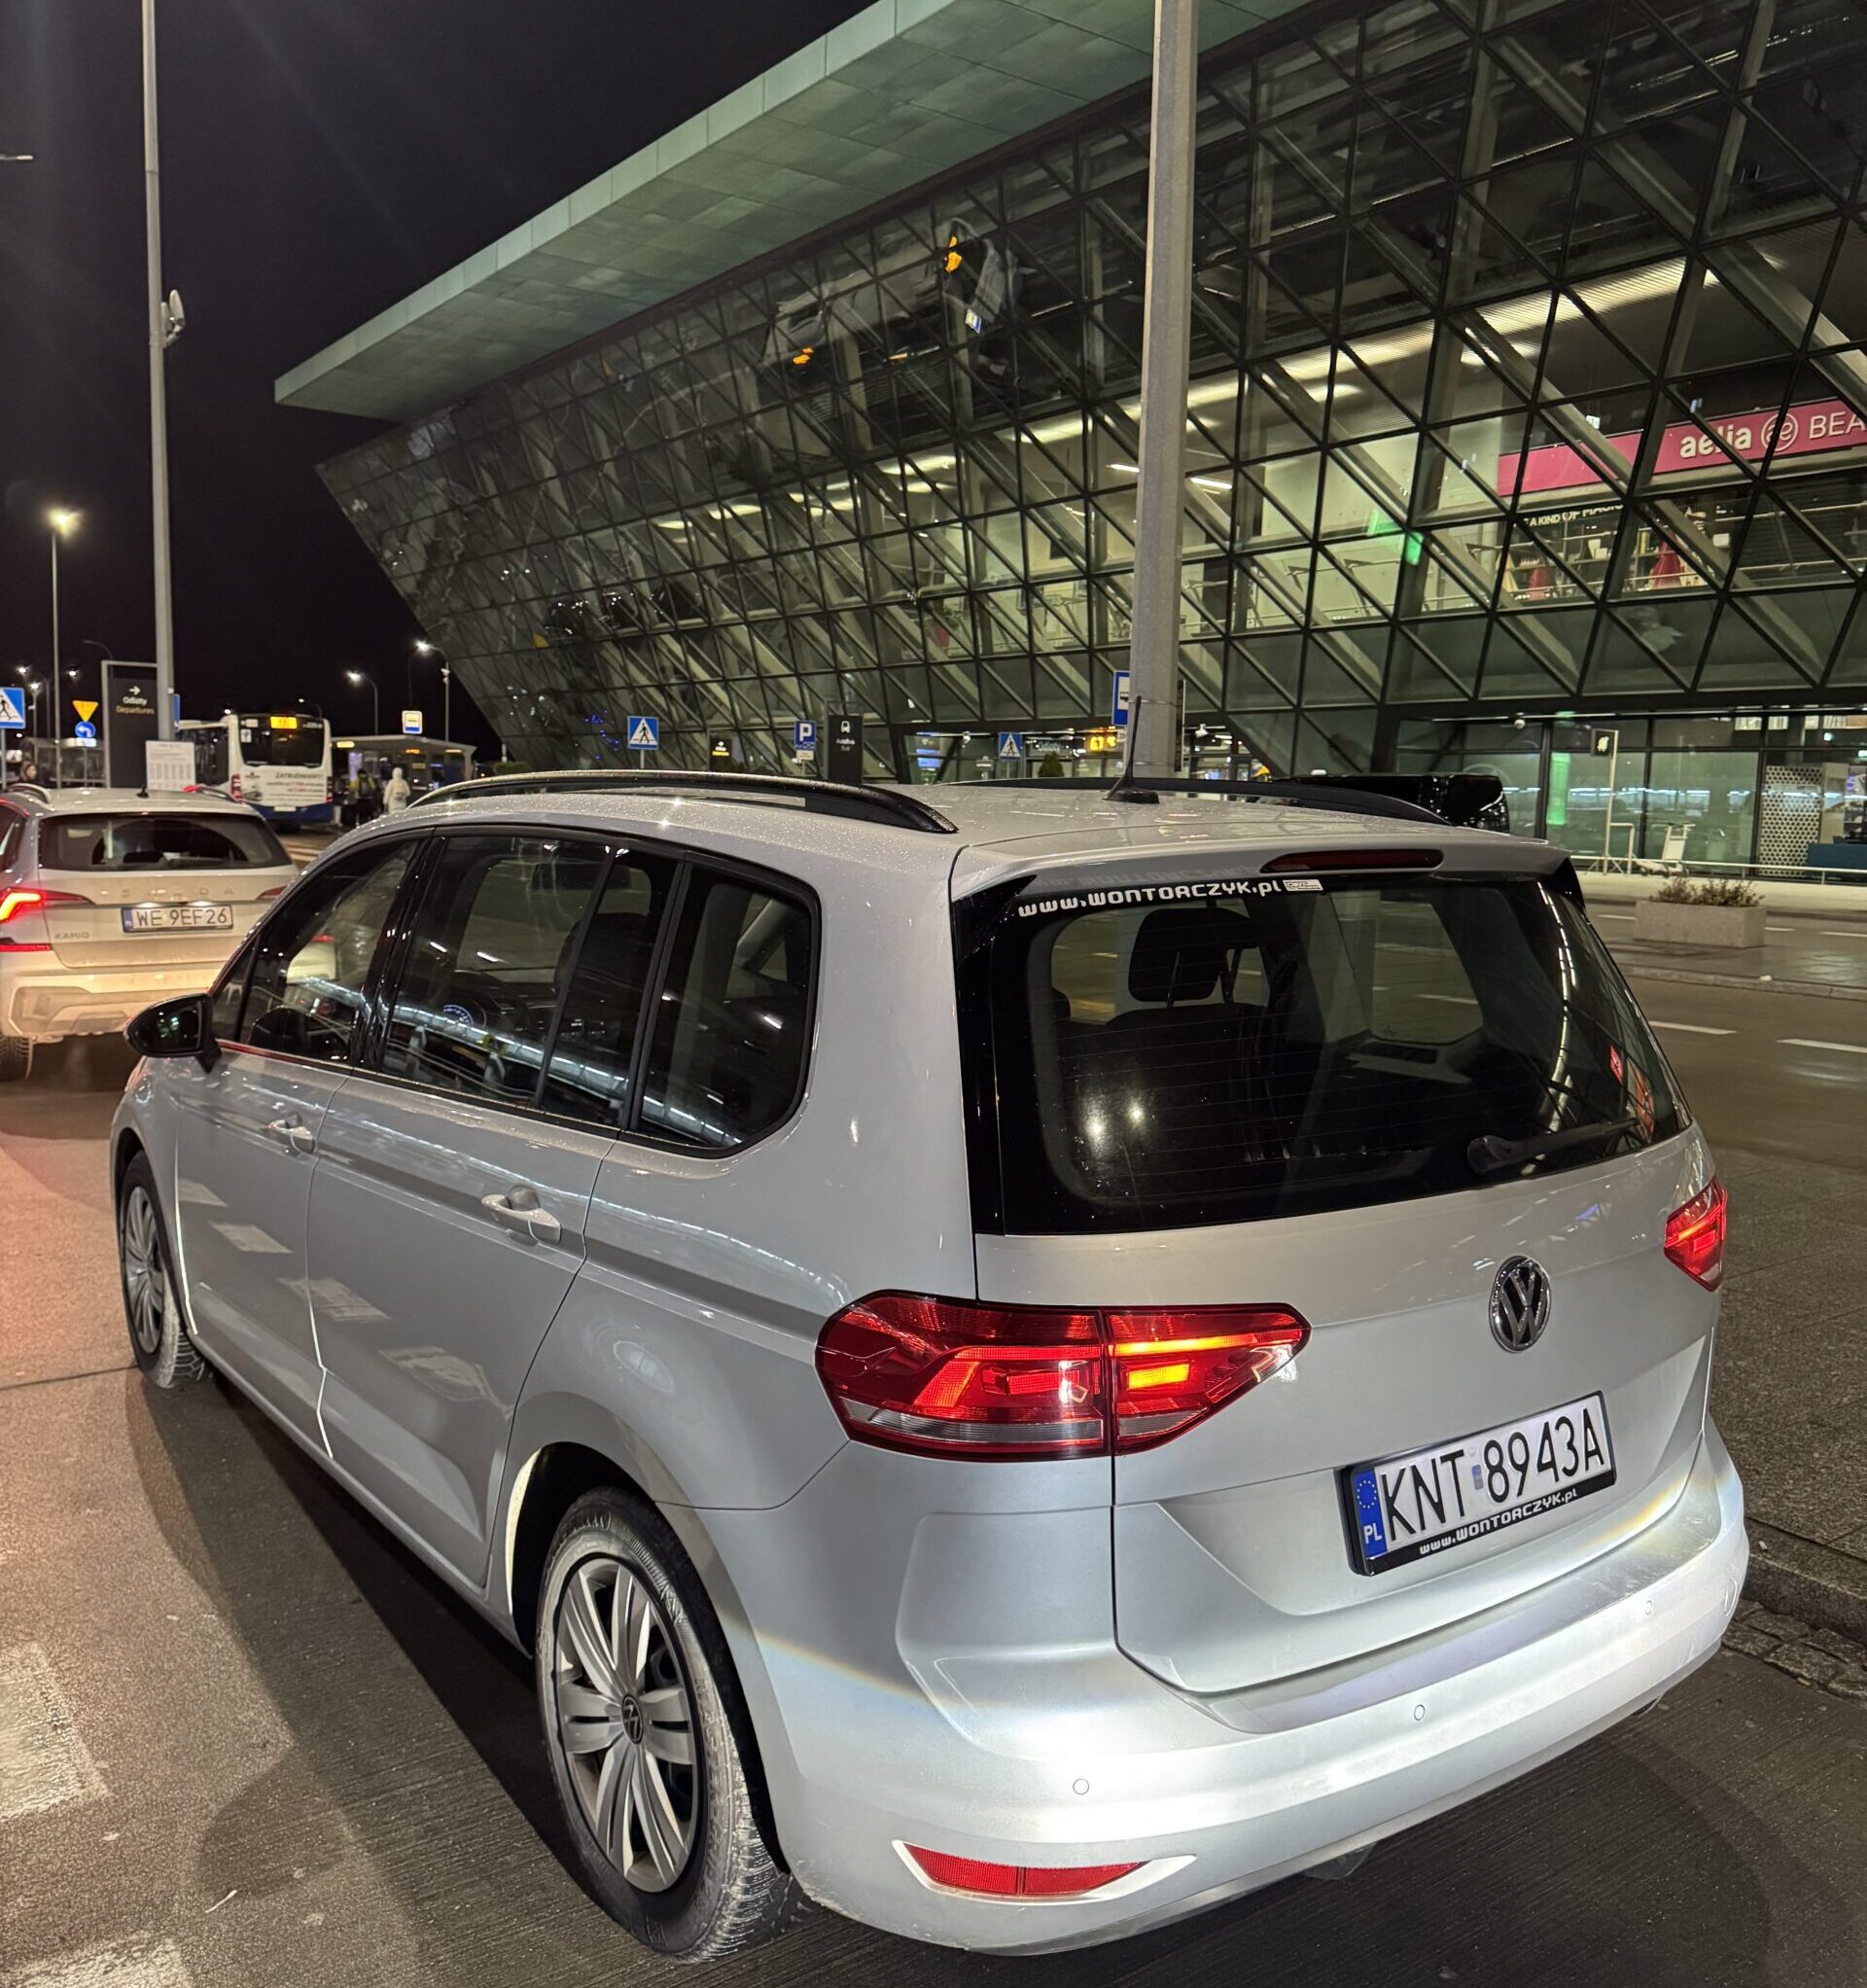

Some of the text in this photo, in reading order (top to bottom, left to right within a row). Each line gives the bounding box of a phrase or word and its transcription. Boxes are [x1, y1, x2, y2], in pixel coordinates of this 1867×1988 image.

[1679, 424, 1751, 459] aelia
[1537, 514, 1561, 526] KIND
[1562, 511, 1580, 521] OF
[116, 705, 156, 715] Departures
[798, 723, 812, 742] P
[1018, 879, 1282, 918] www.WONTORCZYK.pl
[136, 907, 228, 927] WE 9EF26
[1381, 1407, 1604, 1542] KNT 8943A
[1419, 1488, 1577, 1555] www.WONTORCZYK.pl
[1363, 1522, 1383, 1544] PL
